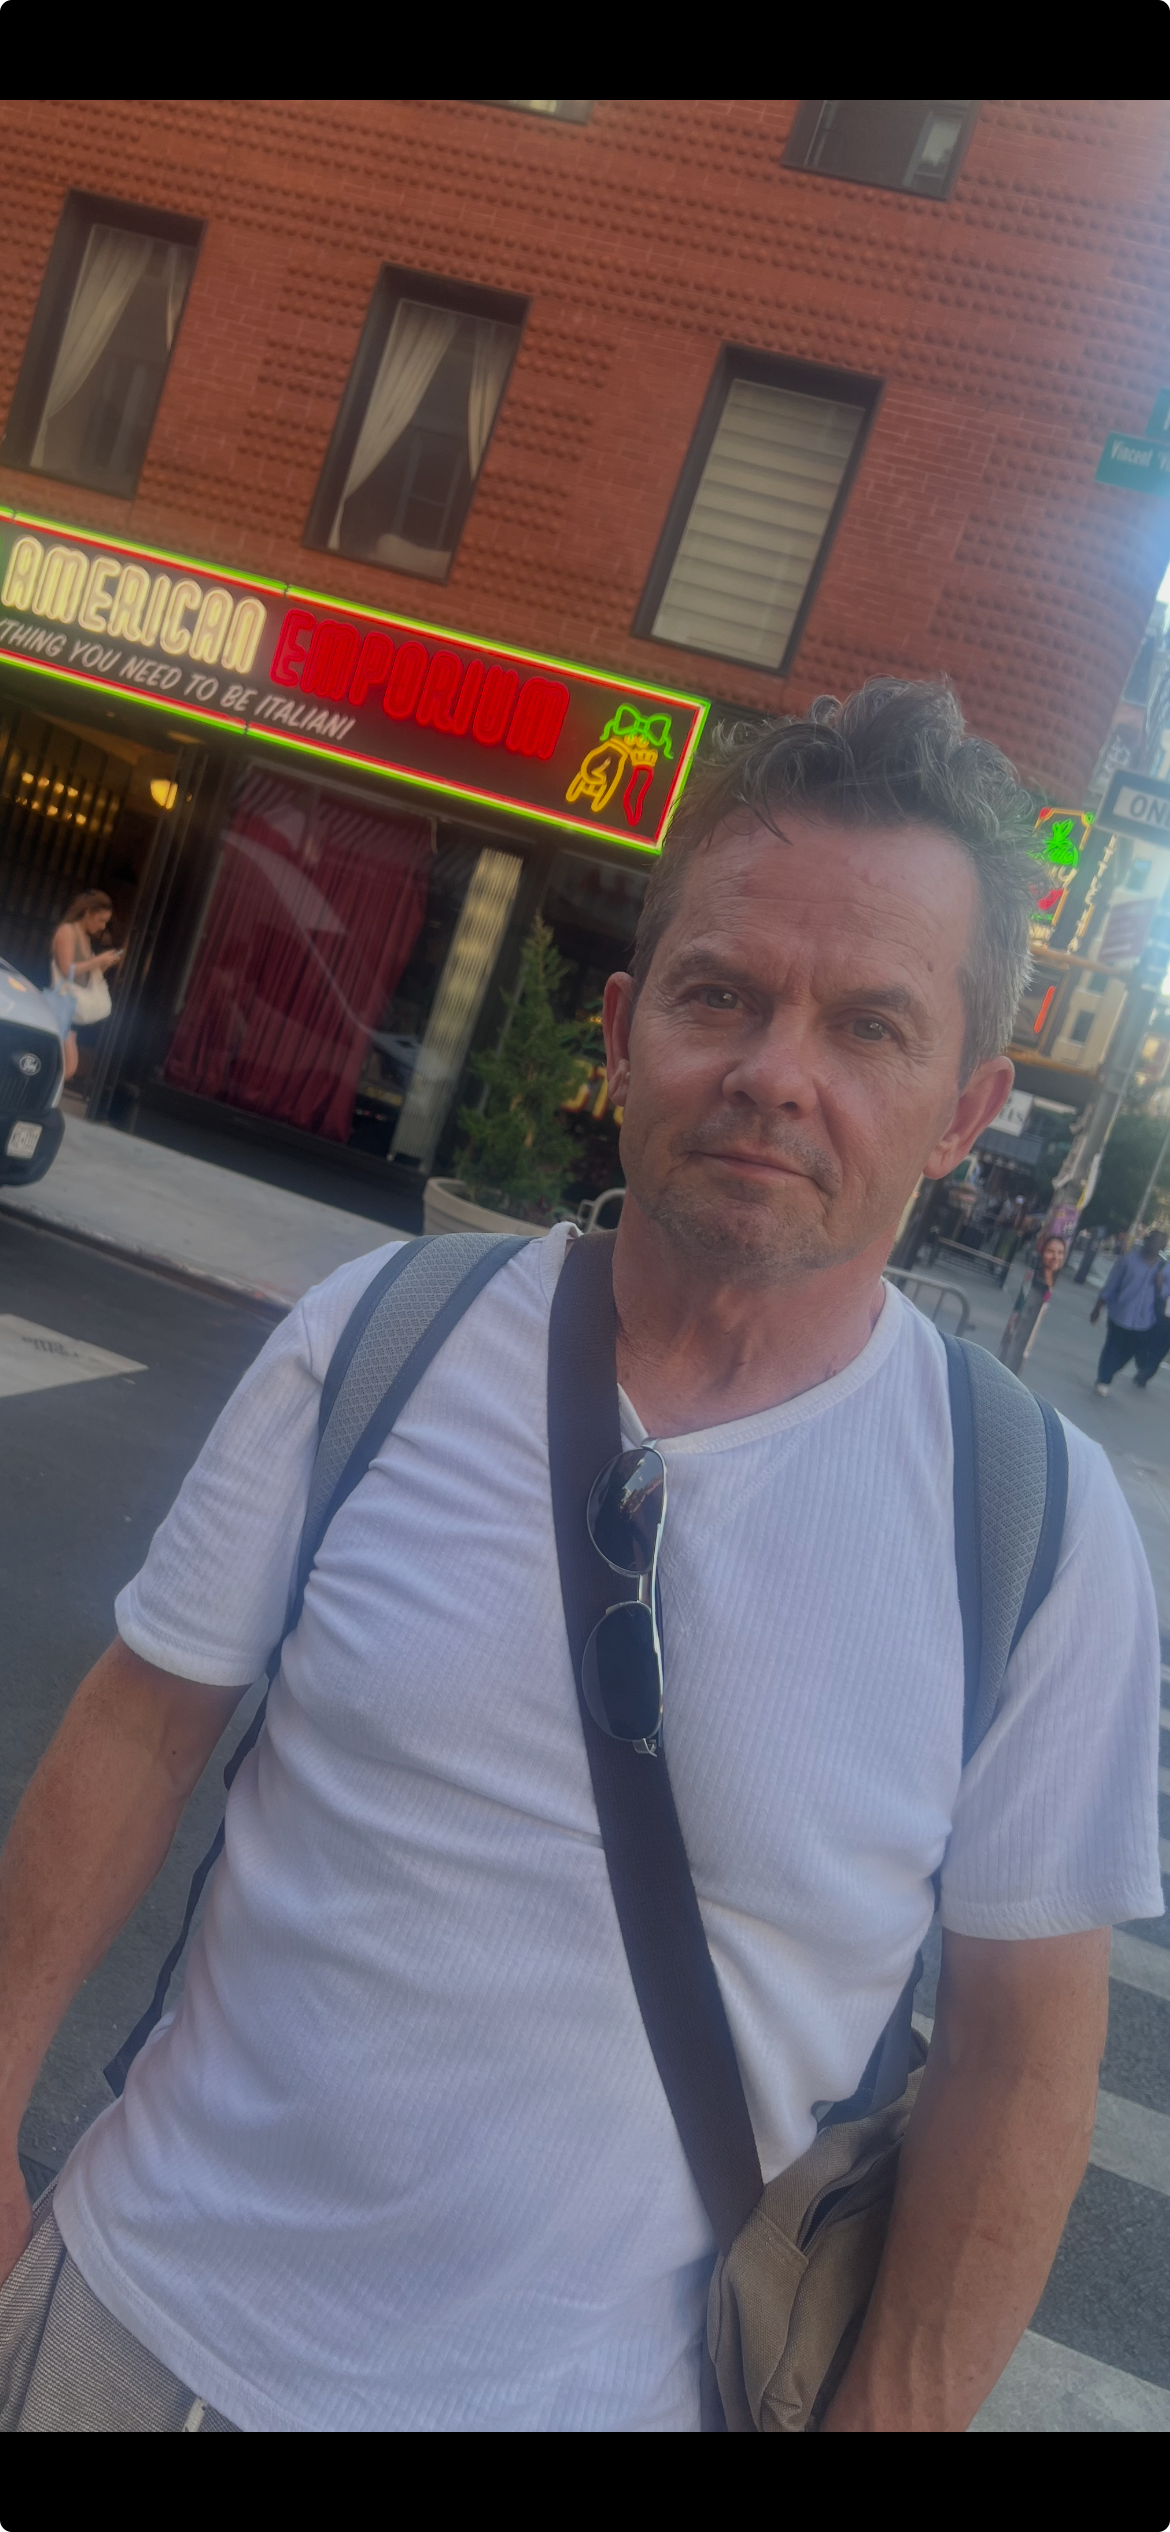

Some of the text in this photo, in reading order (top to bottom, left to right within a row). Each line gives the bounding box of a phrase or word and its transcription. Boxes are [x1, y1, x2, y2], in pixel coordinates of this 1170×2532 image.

[0, 618, 67, 657] THING
[68, 639, 122, 672] YOU
[119, 651, 182, 690] NEED
[183, 672, 219, 701] TO
[220, 684, 257, 711] BE
[1, 535, 570, 760] AMERICAN EMPORIUM
[1130, 794, 1170, 846] ON
